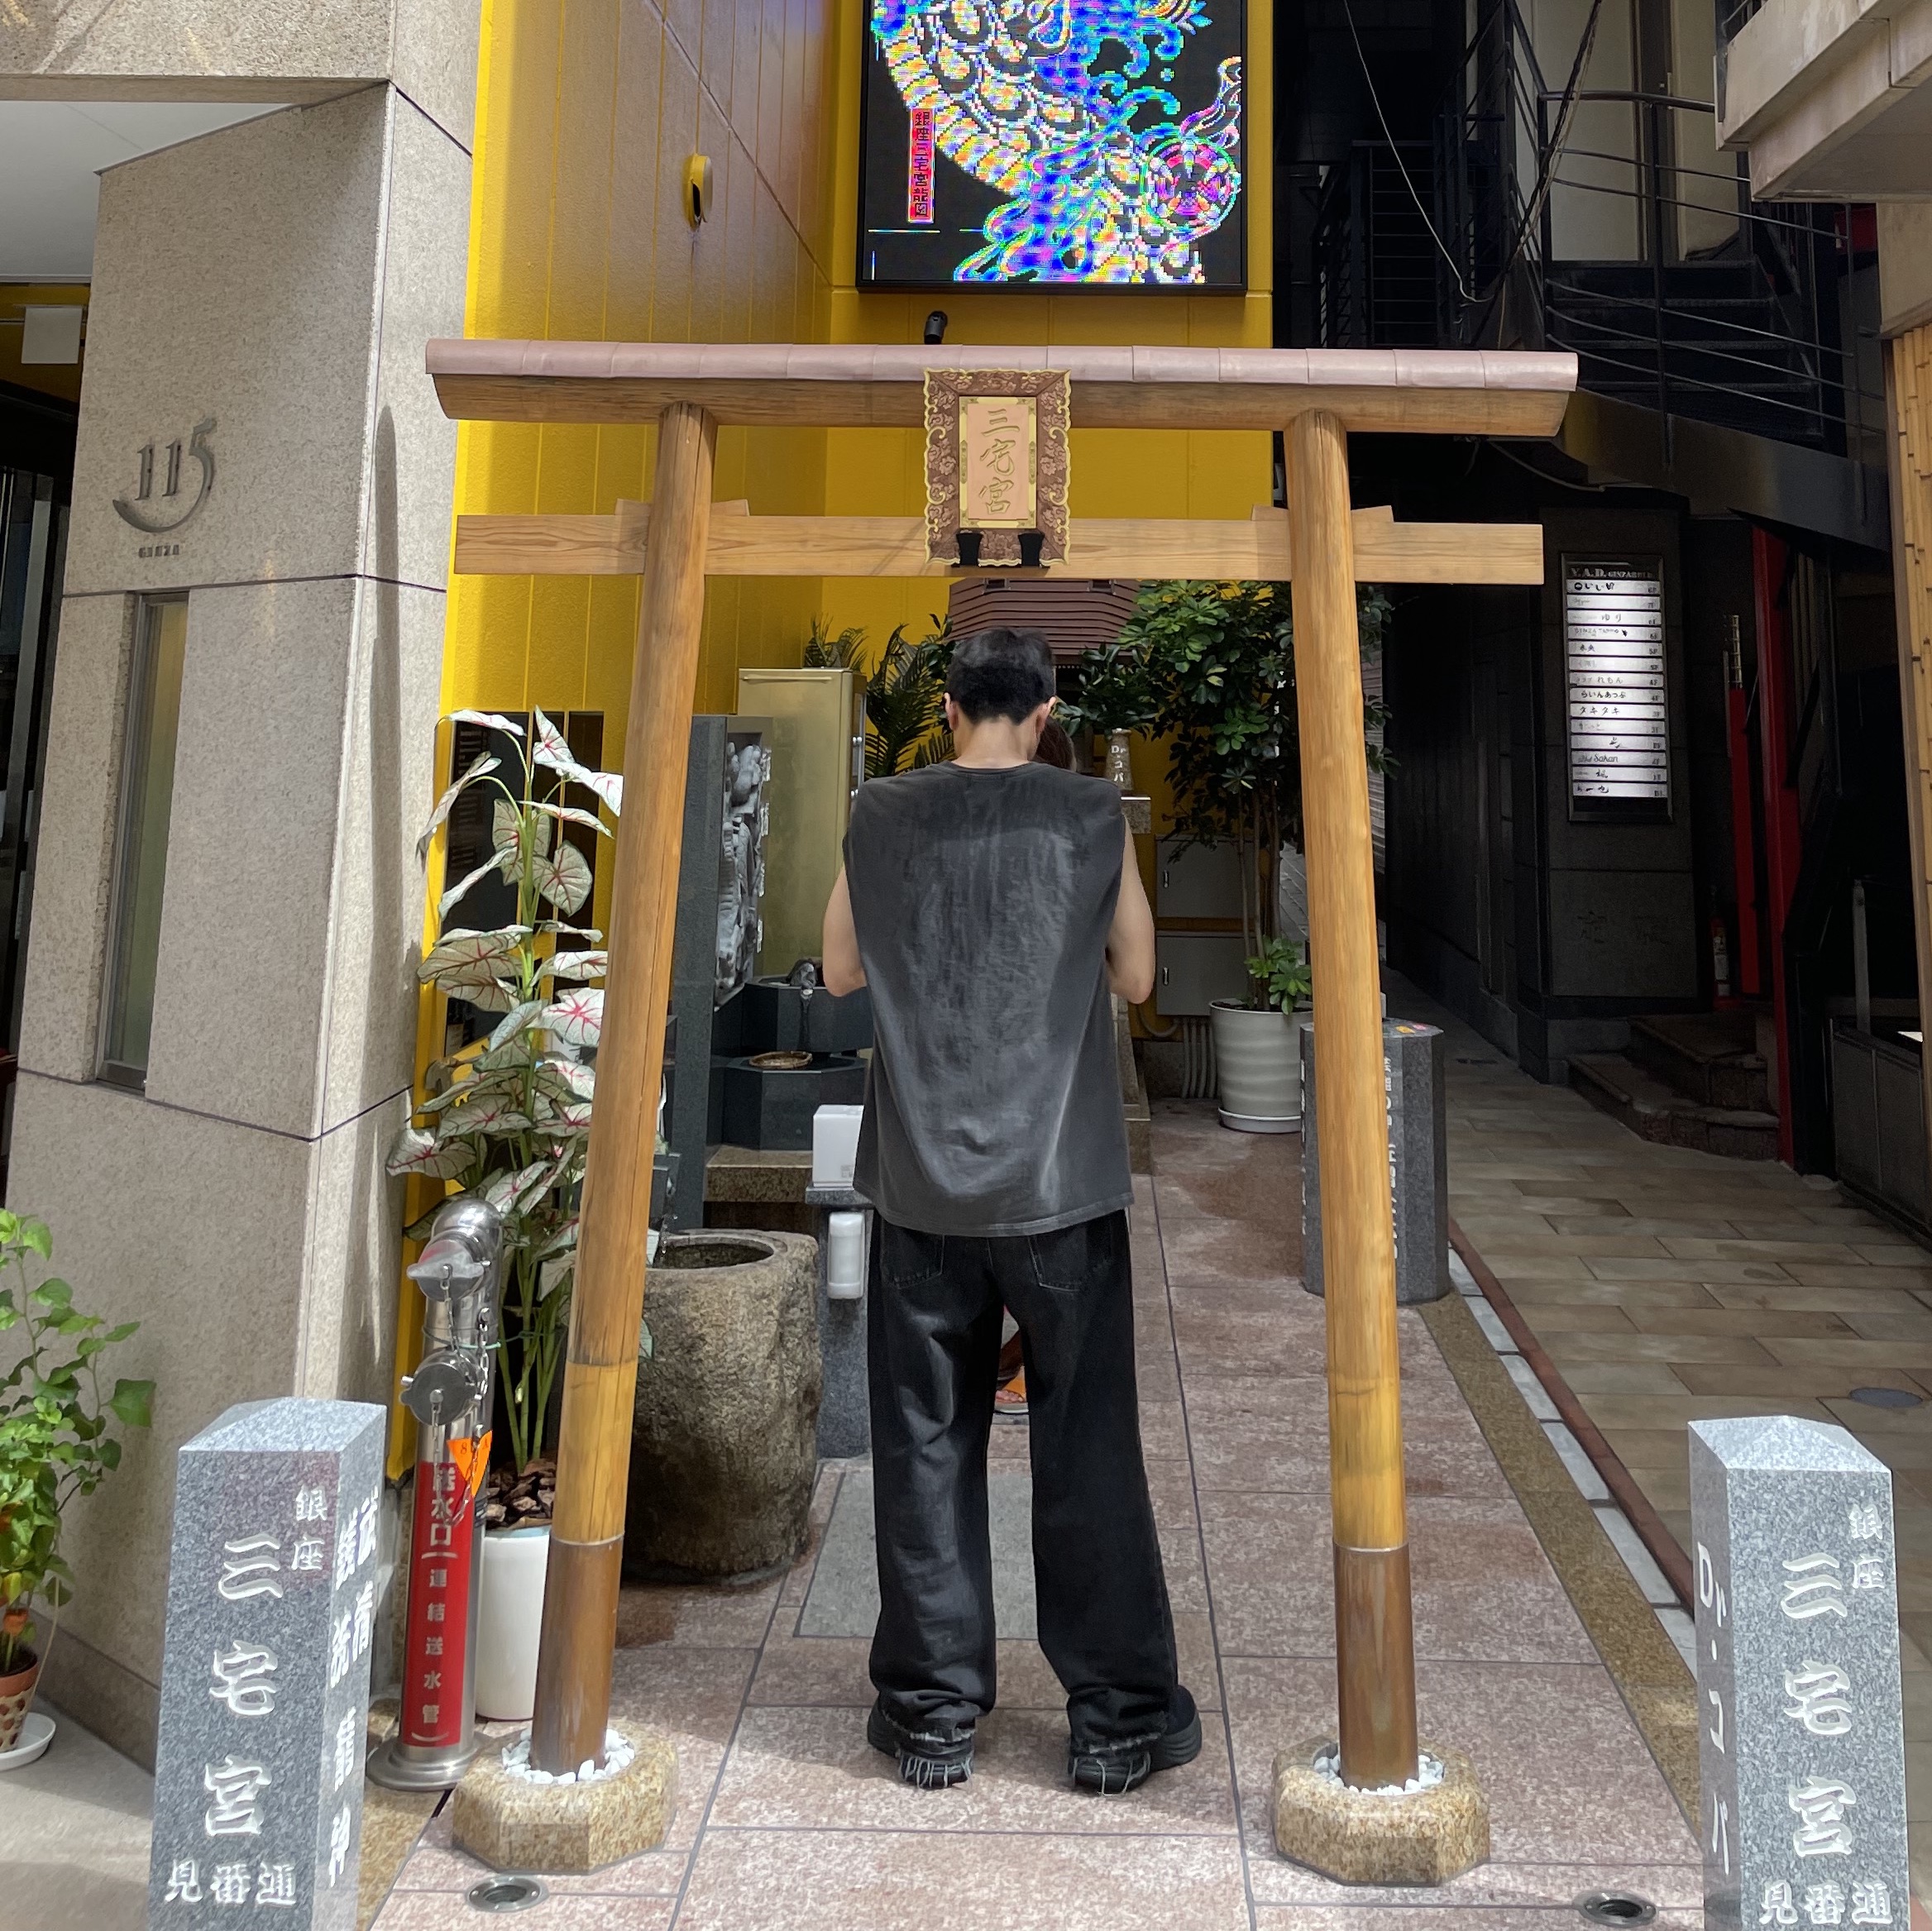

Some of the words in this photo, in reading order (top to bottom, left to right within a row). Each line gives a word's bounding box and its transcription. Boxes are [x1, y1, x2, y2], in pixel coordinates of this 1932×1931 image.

[112, 416, 217, 533] 115
[978, 408, 1020, 514] 三宅宮
[292, 1486, 328, 1572] 銀座
[1848, 1503, 1885, 1589] 銀座
[205, 1533, 282, 1837] 三宅宮
[1781, 1552, 1858, 1857] 三宅宮
[165, 1859, 297, 1905] 見番通
[1759, 1880, 1893, 1924] 見番通
